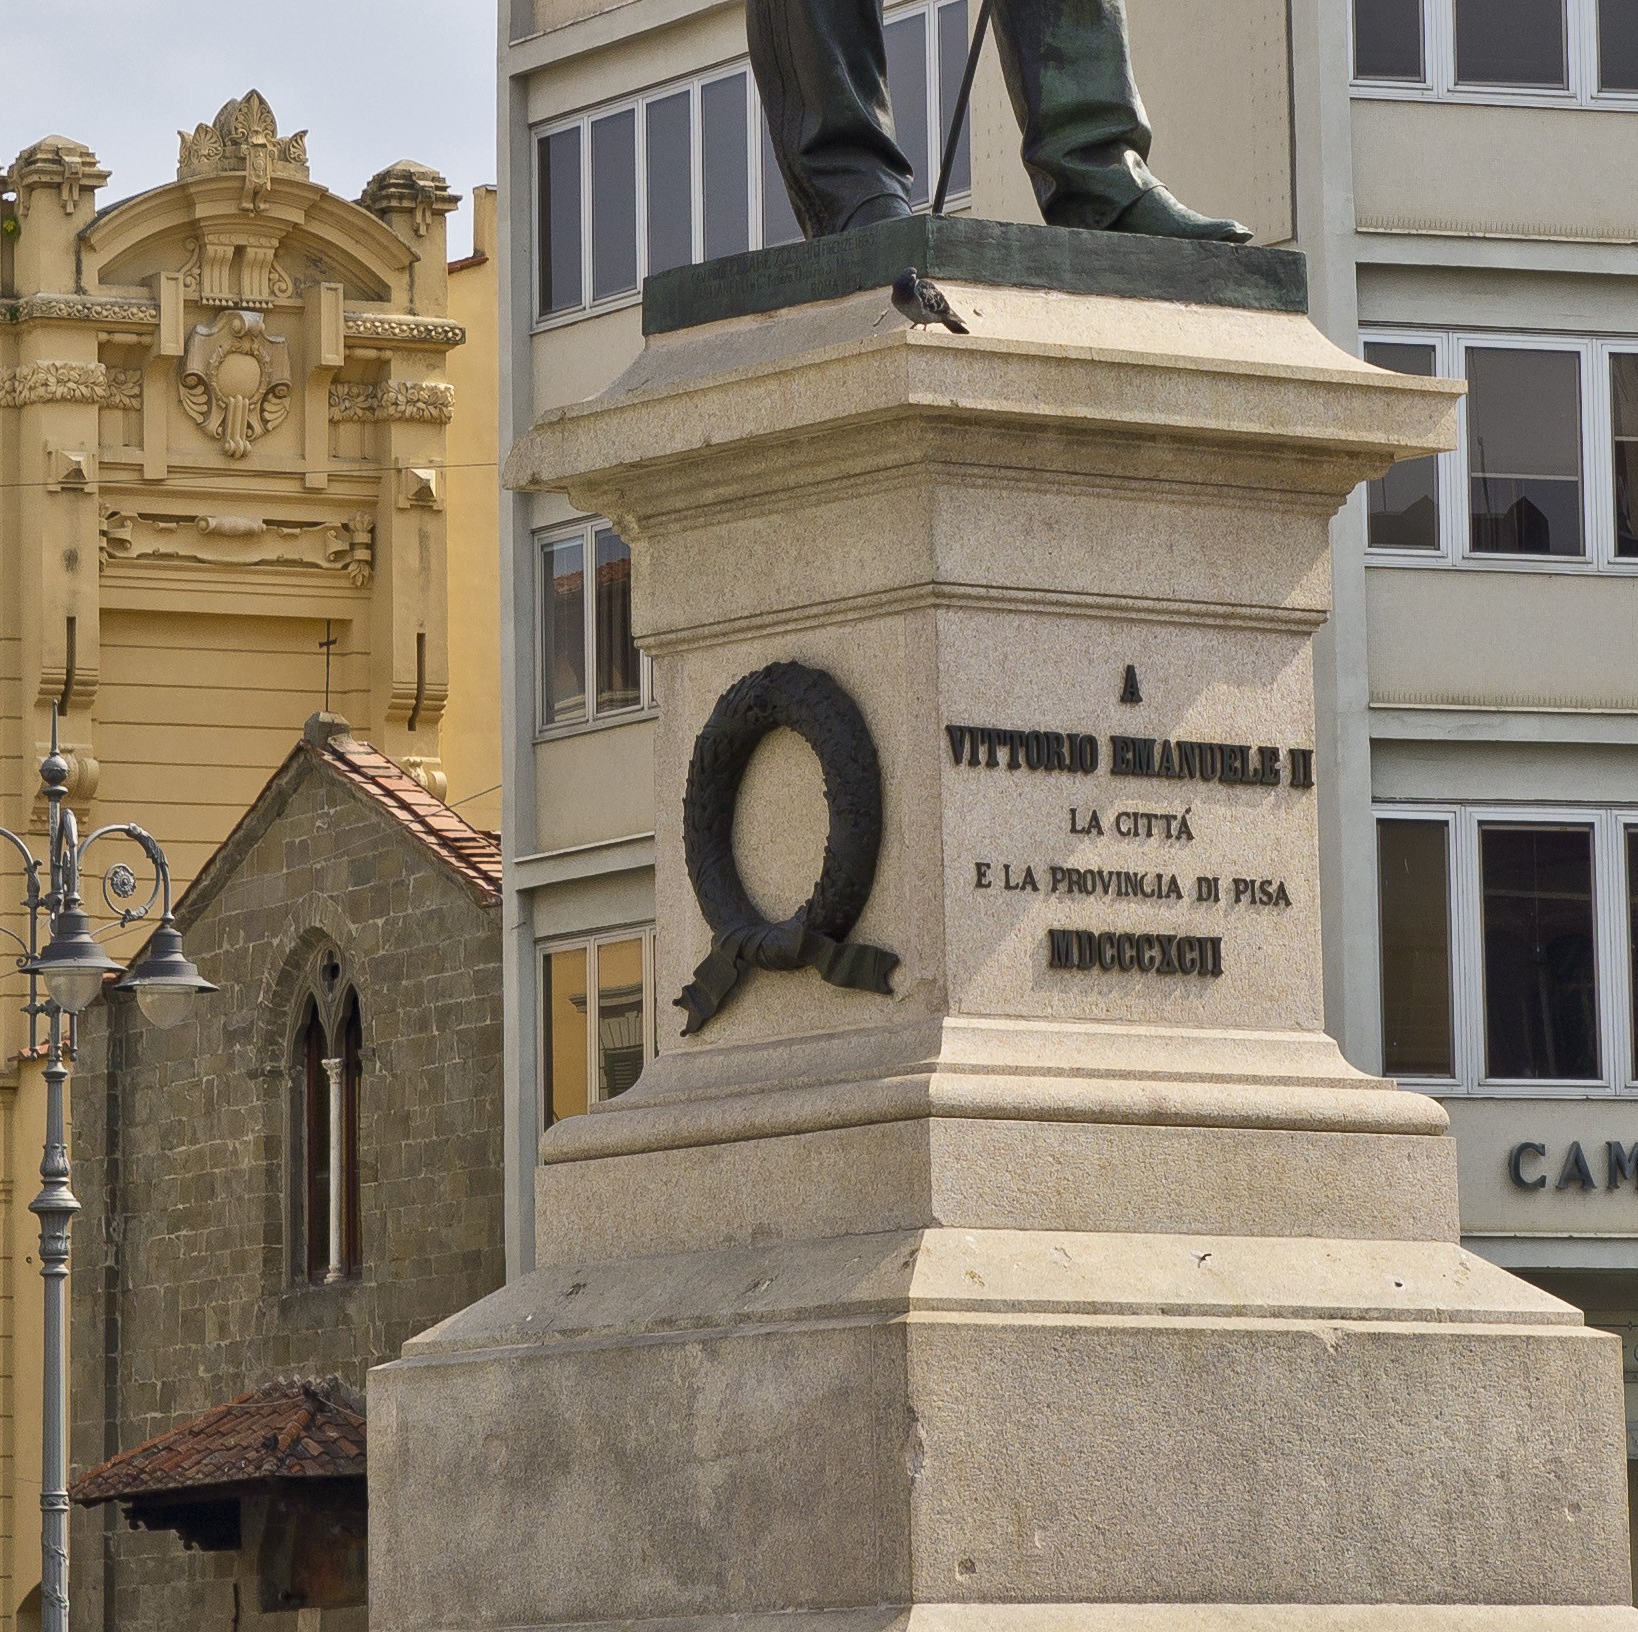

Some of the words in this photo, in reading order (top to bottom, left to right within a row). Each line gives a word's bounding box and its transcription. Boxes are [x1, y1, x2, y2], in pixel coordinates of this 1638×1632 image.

[1119, 664, 1143, 704] A
[945, 724, 1100, 774] VITTORIO
[1110, 735, 1281, 786] EMANUELE
[1289, 748, 1314, 789] II
[1069, 808, 1104, 836] LA
[974, 862, 992, 889] E
[1003, 863, 1040, 893] LA
[1049, 865, 1183, 900] PROVINCIA
[1196, 876, 1221, 903] DI
[1232, 878, 1293, 907] PISA
[1048, 929, 1223, 977] MDCCCXCII
